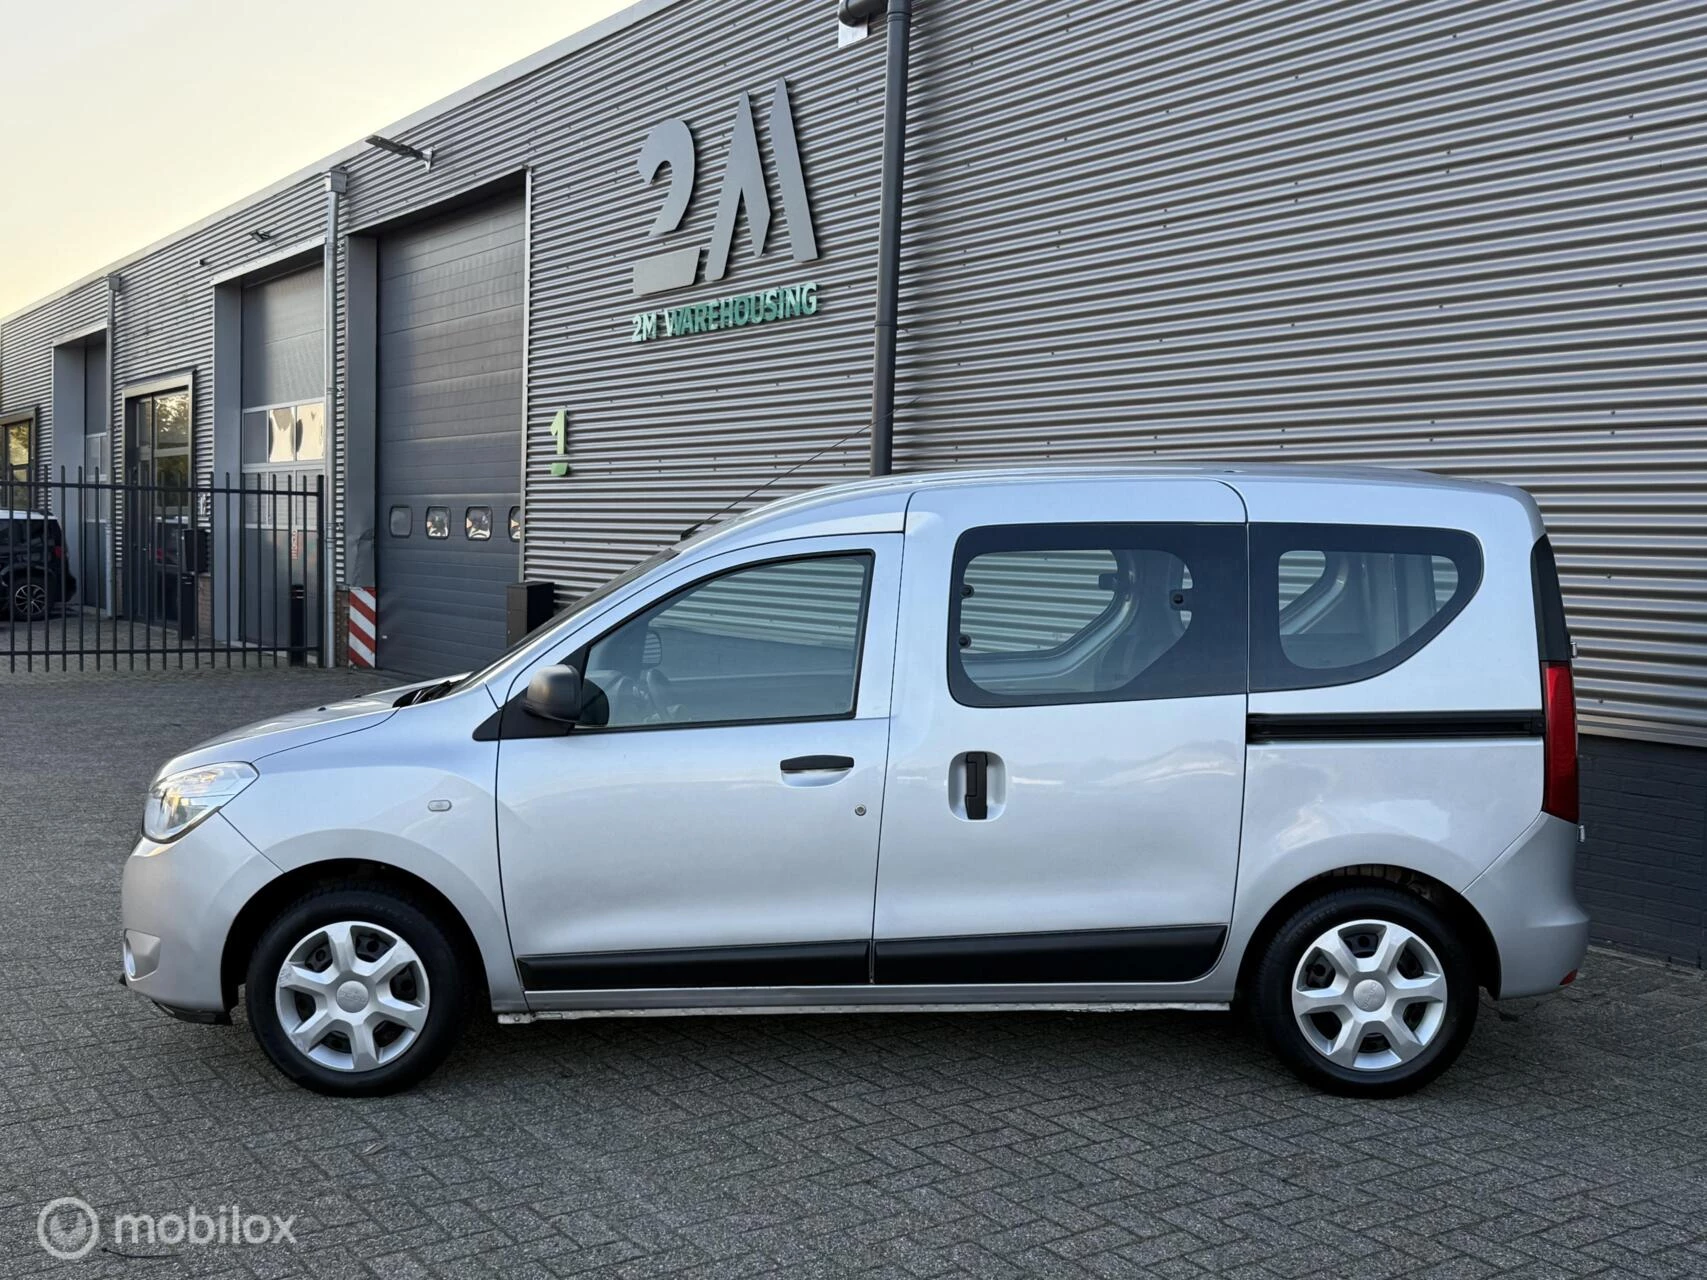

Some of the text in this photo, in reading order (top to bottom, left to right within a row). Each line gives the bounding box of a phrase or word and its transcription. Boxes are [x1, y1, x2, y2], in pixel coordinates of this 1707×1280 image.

[633, 76, 818, 296] 2M
[632, 282, 817, 342] 2M WAREHOUSING
